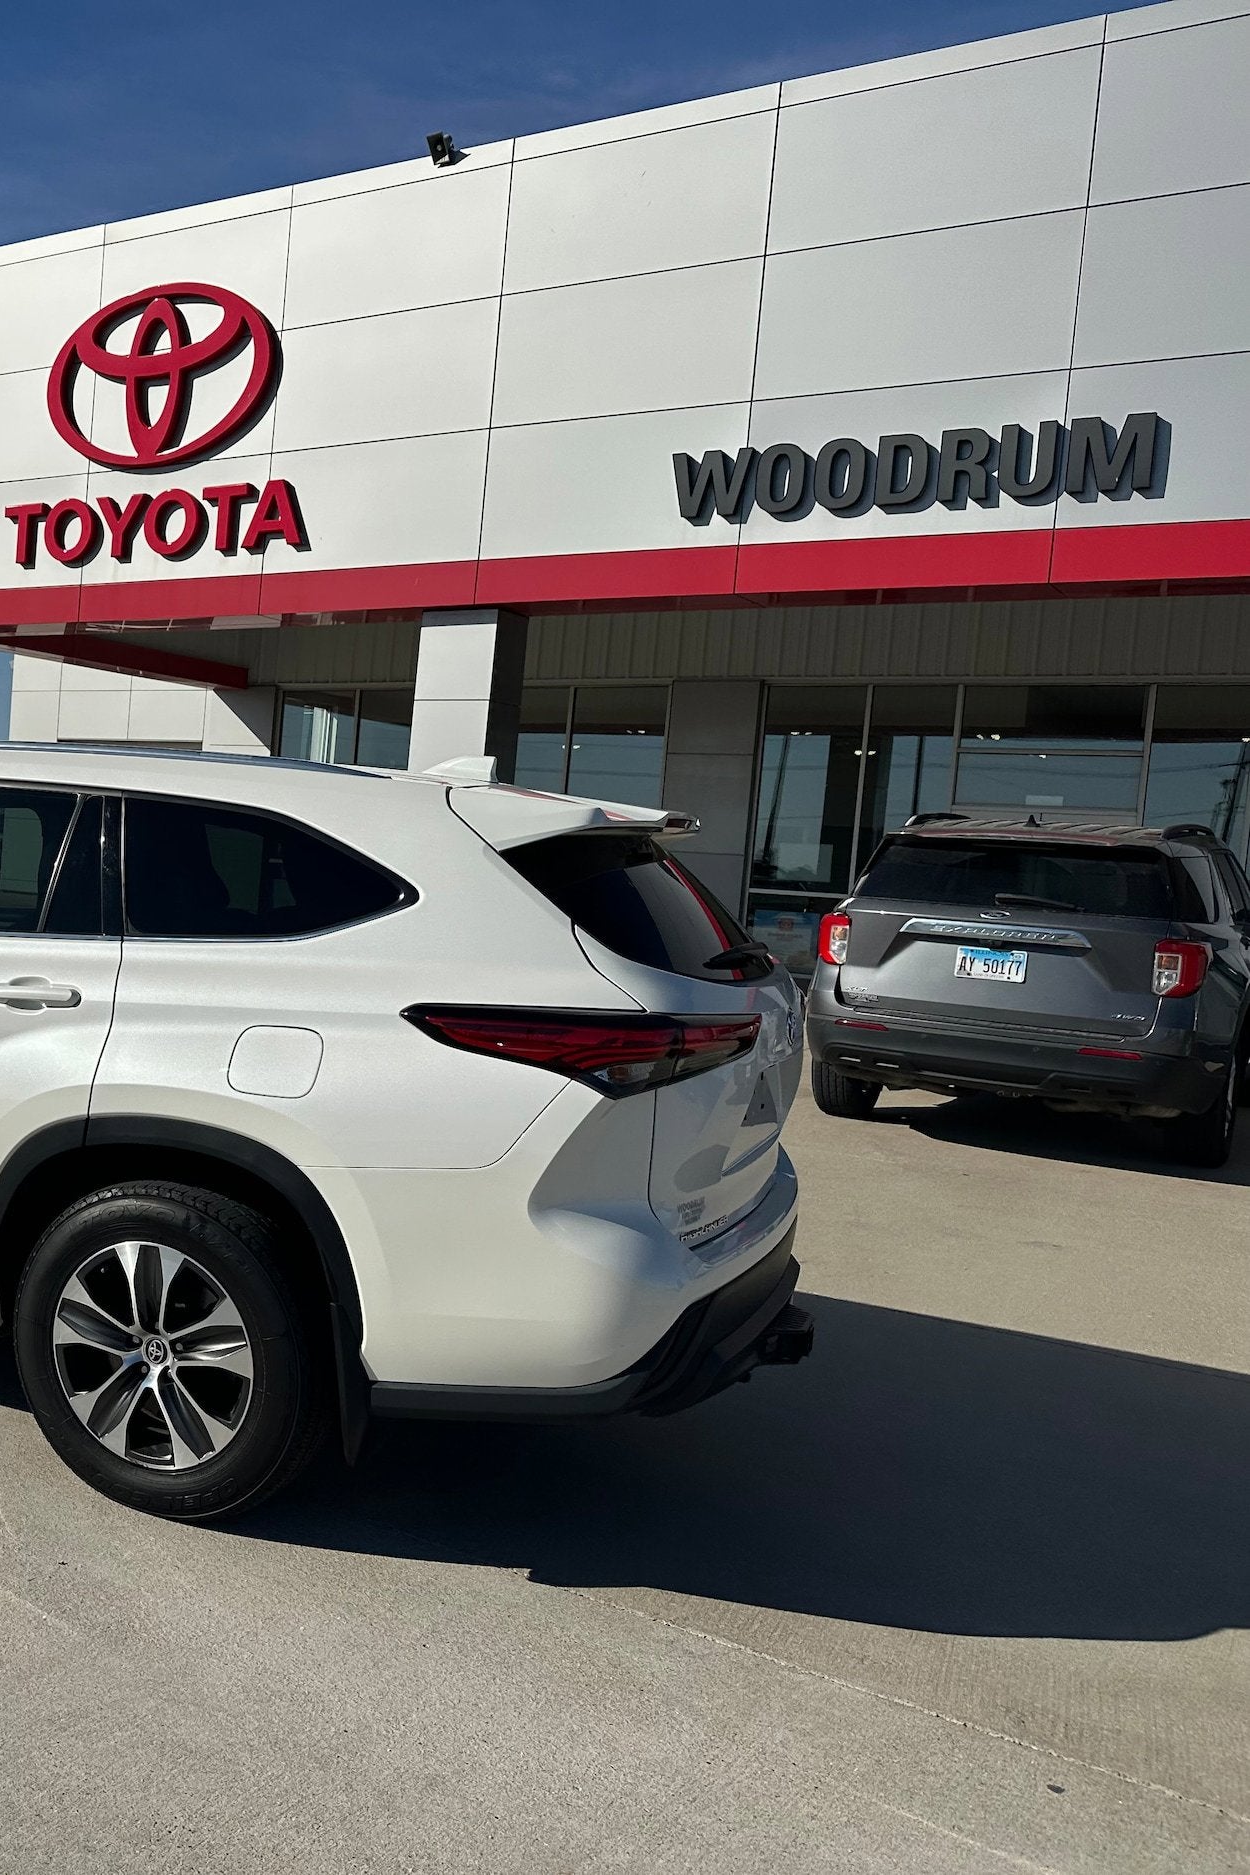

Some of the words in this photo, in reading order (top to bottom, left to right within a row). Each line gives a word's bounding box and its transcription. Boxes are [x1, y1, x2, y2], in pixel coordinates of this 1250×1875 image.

[673, 412, 1170, 525] WOODRUM
[5, 480, 308, 568] TOYOTA
[959, 956, 976, 972] AY
[983, 958, 1023, 976] 50177
